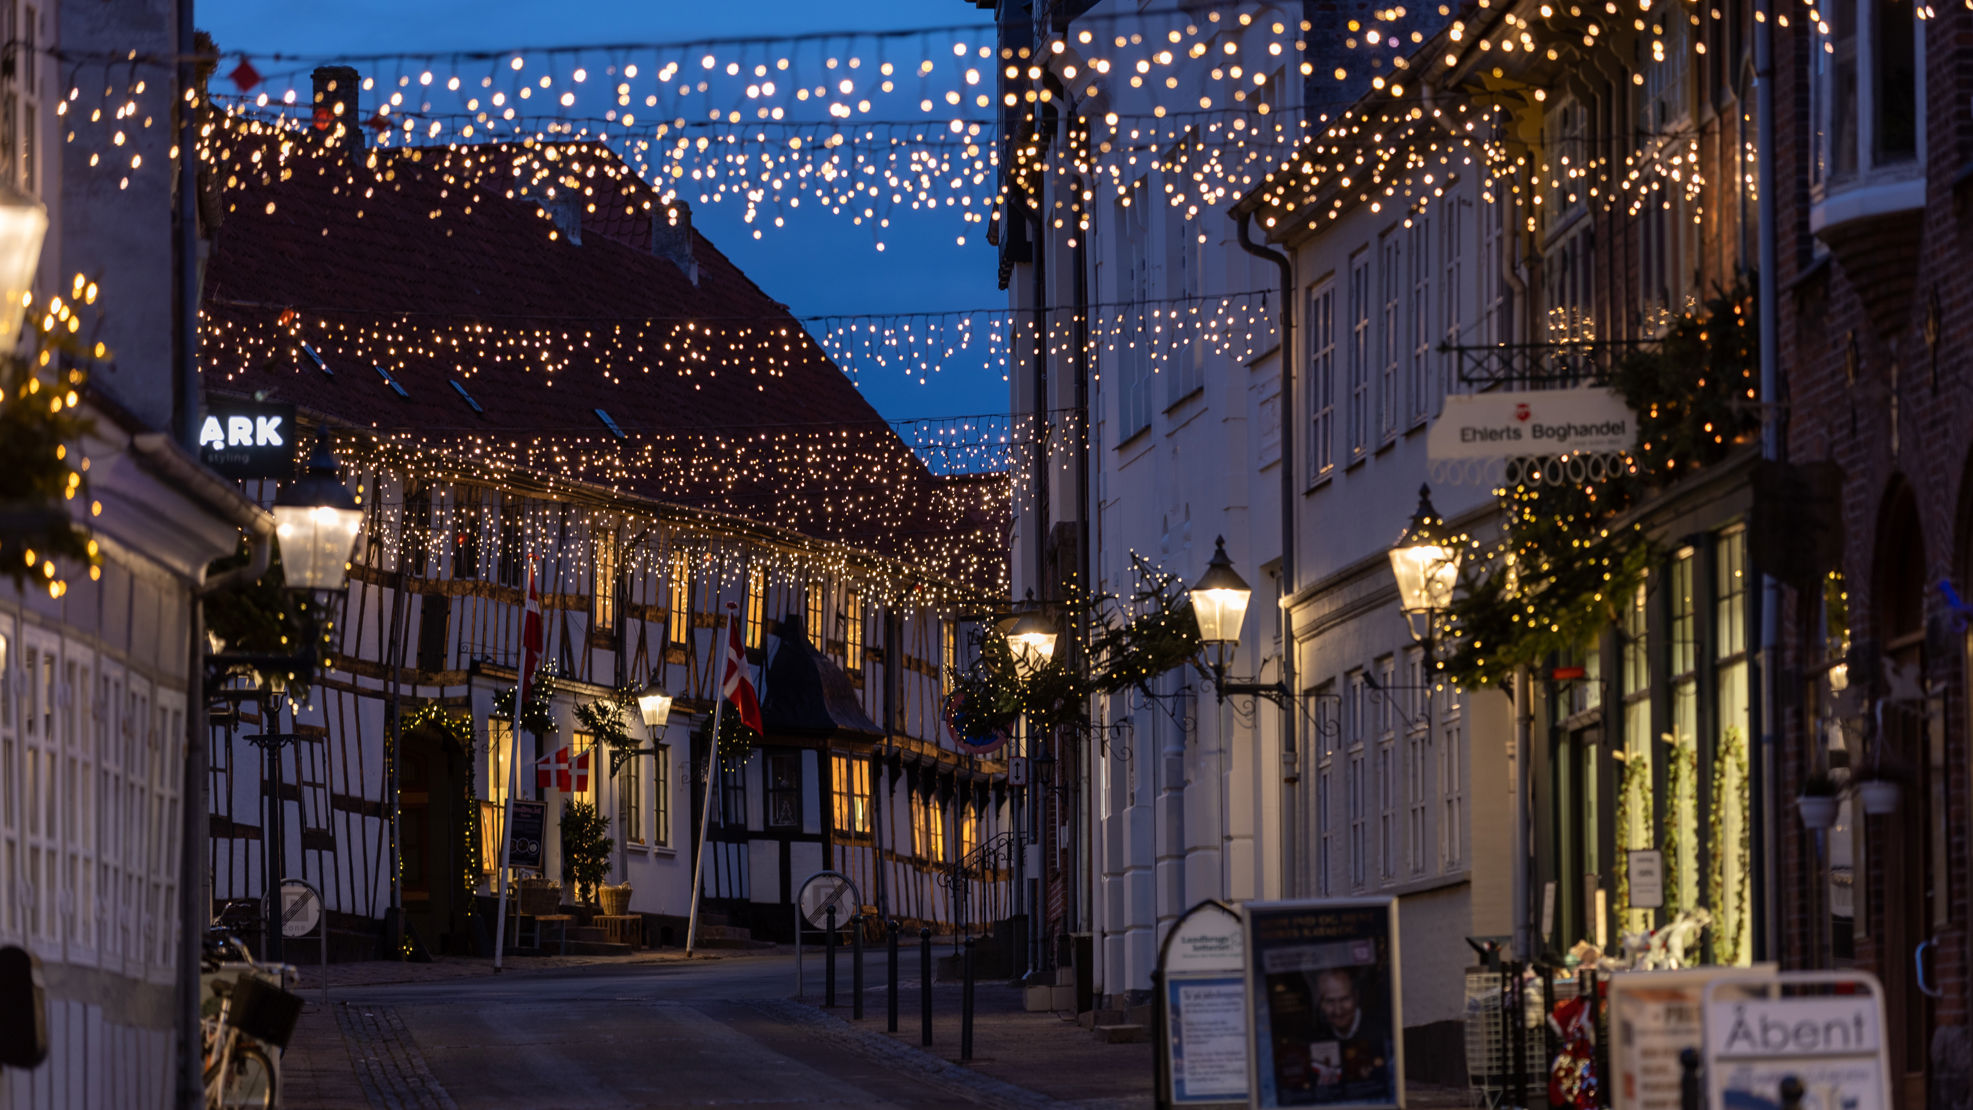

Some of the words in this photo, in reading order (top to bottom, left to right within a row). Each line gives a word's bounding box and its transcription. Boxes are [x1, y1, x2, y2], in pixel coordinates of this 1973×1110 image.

[200, 416, 283, 450] ARK
[1460, 425, 1522, 444] Ehlerts
[1532, 420, 1626, 442] Boghandel
[208, 452, 250, 464] styling
[1724, 1004, 1865, 1051] Åbent
